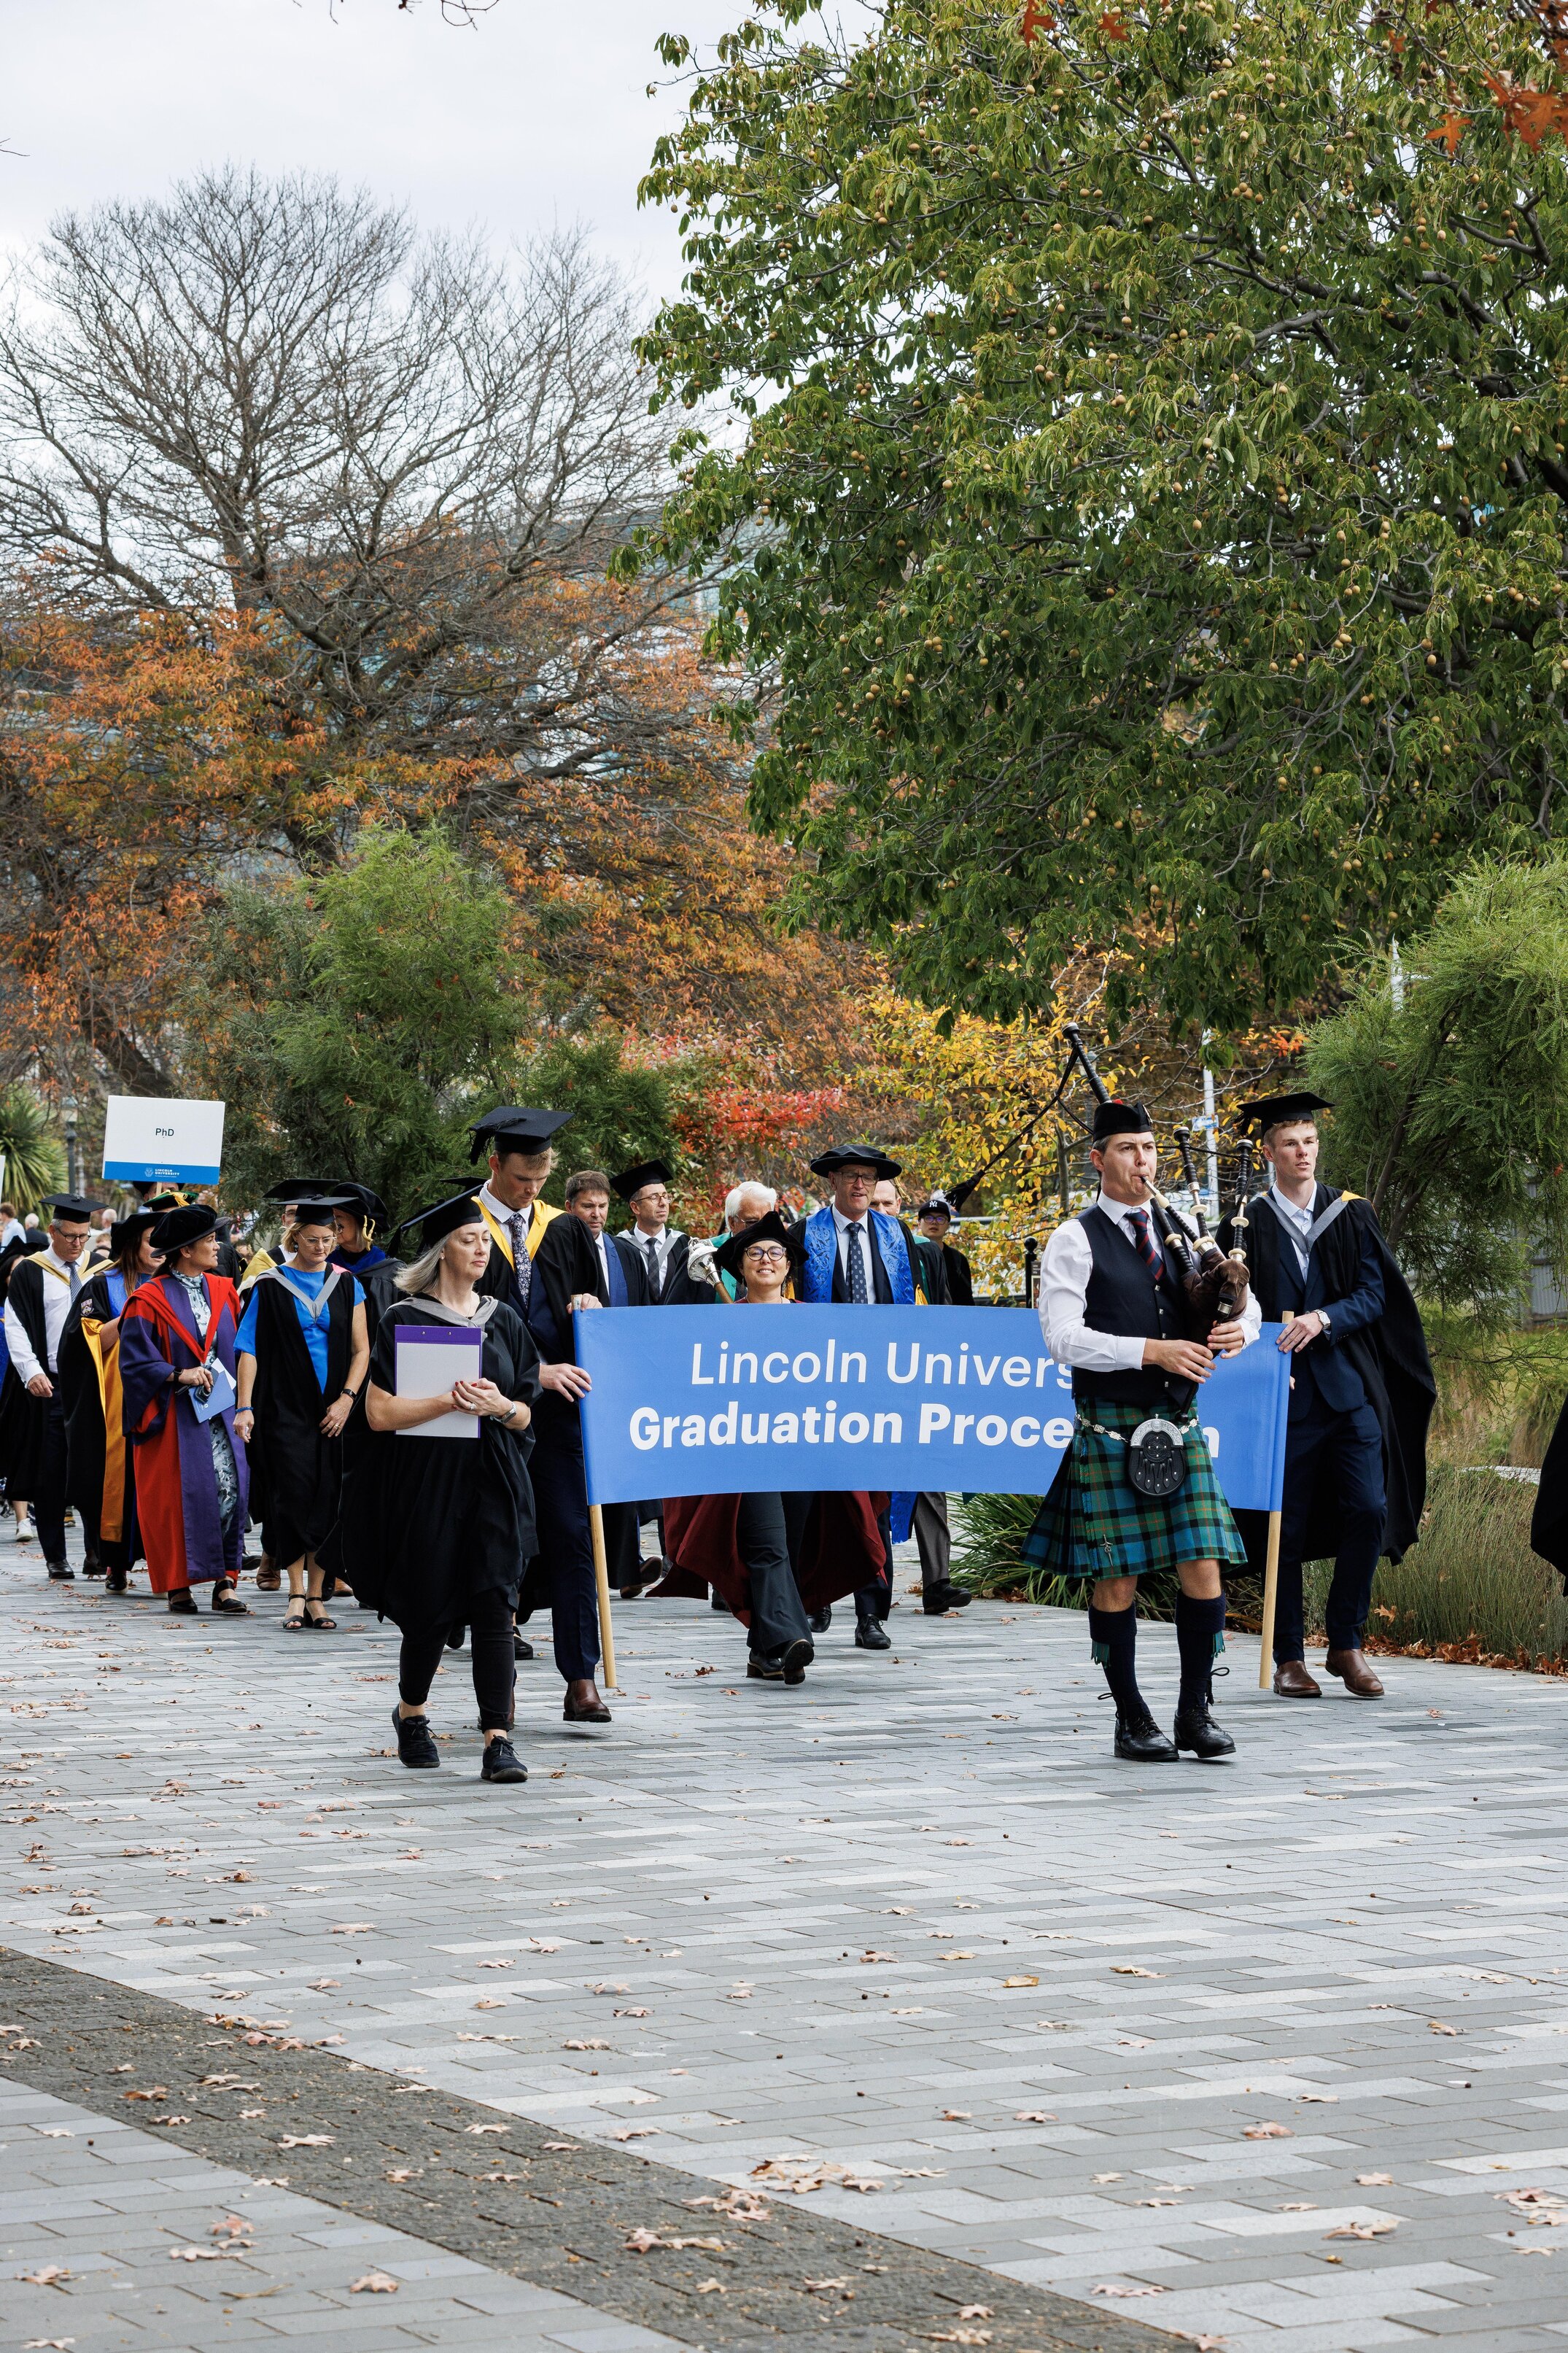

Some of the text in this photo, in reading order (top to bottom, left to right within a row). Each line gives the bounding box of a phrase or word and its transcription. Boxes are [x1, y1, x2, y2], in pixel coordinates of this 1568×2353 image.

[155, 1128, 174, 1136] PhD
[691, 1338, 867, 1385] Lincoln
[629, 1400, 903, 1451] Graduation
